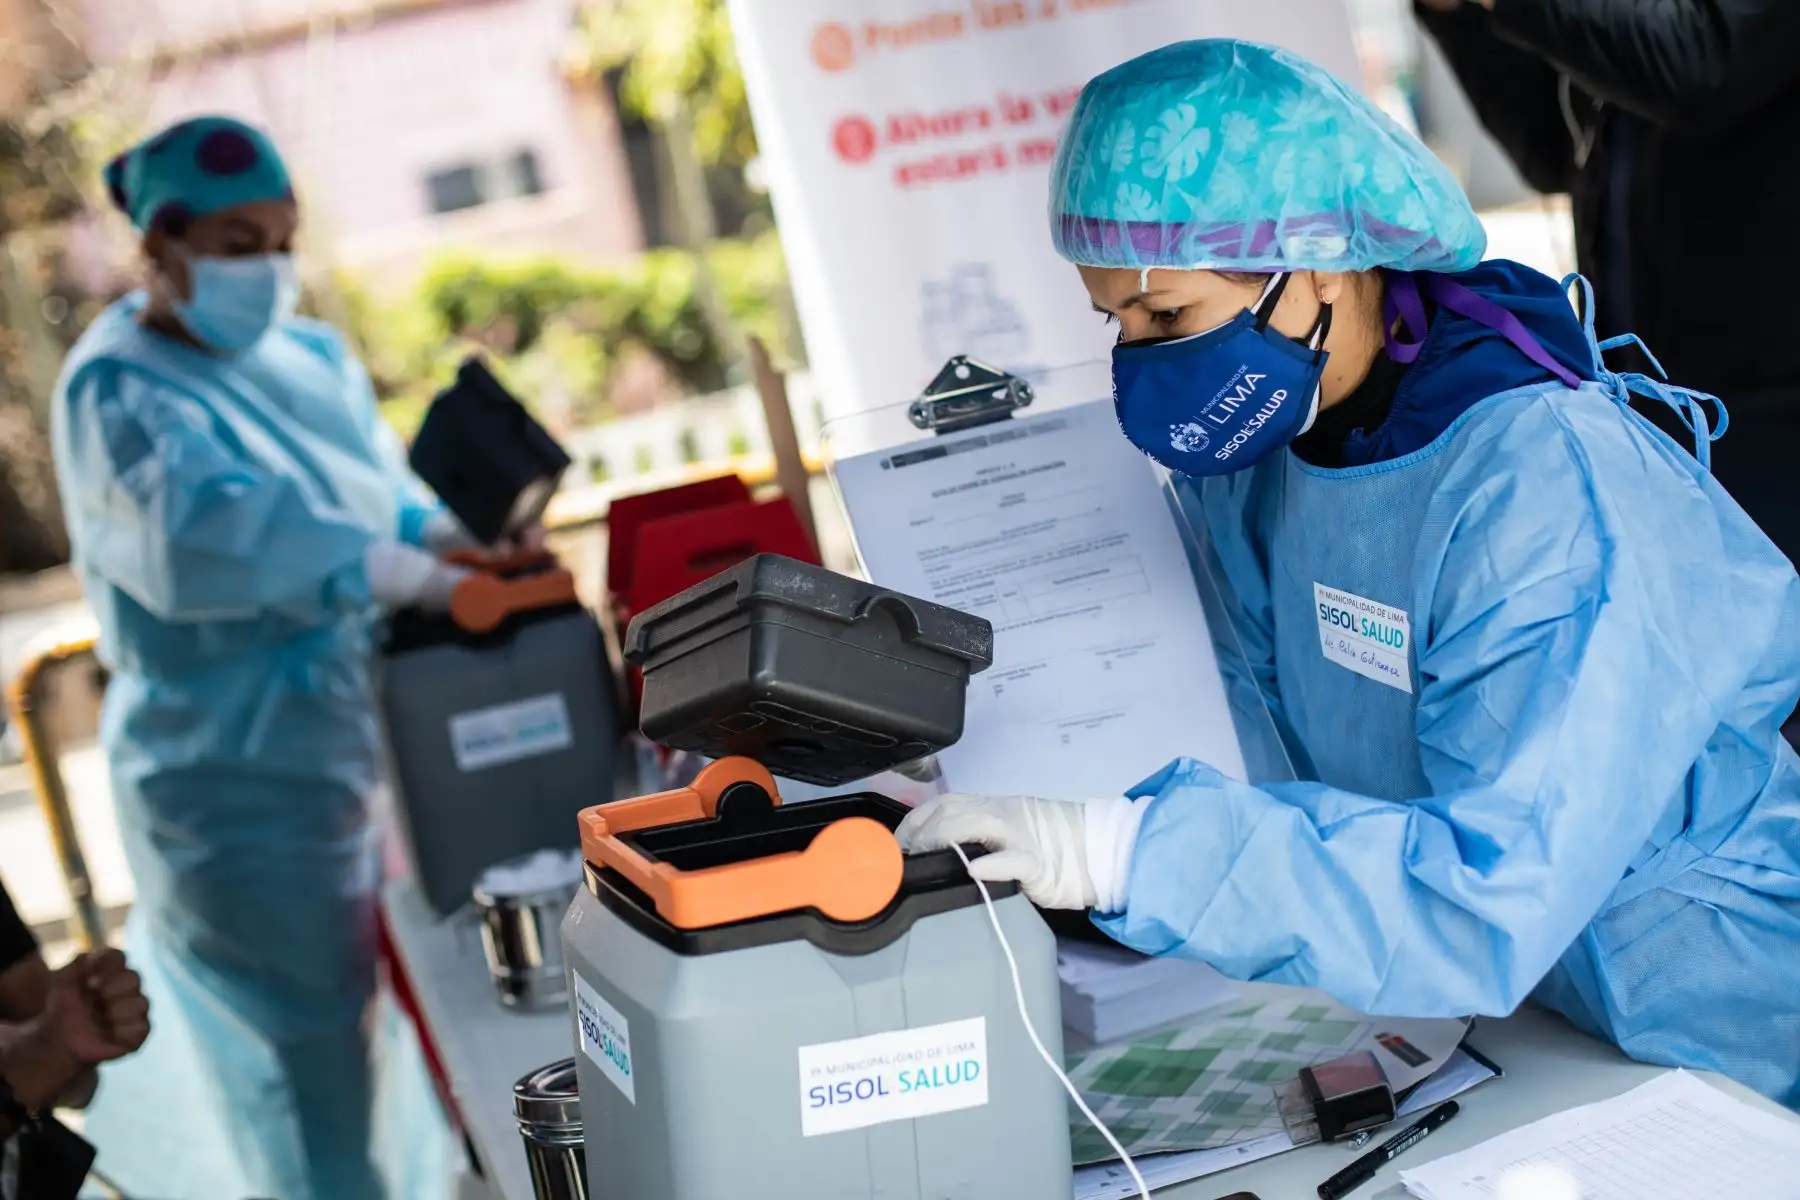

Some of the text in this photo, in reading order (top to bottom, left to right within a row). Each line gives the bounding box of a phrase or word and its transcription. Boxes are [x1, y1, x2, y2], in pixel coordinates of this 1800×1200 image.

[886, 107, 991, 143] Ahora
[998, 94, 1033, 124] la
[1201, 364, 1249, 415] MUNICIPALIDAD DE
[1208, 372, 1267, 425] LIMA
[1215, 388, 1288, 461] SISOL SALUD
[1319, 603, 1404, 649] SISOL SALUD
[1325, 591, 1405, 624] MUNICIPALIDAD DE LIMA
[579, 1009, 630, 1077] SISOL SALUD
[826, 1041, 976, 1076] MUNICIPALIDAD DE LIMA
[809, 1060, 981, 1108] SISOL SALUD
